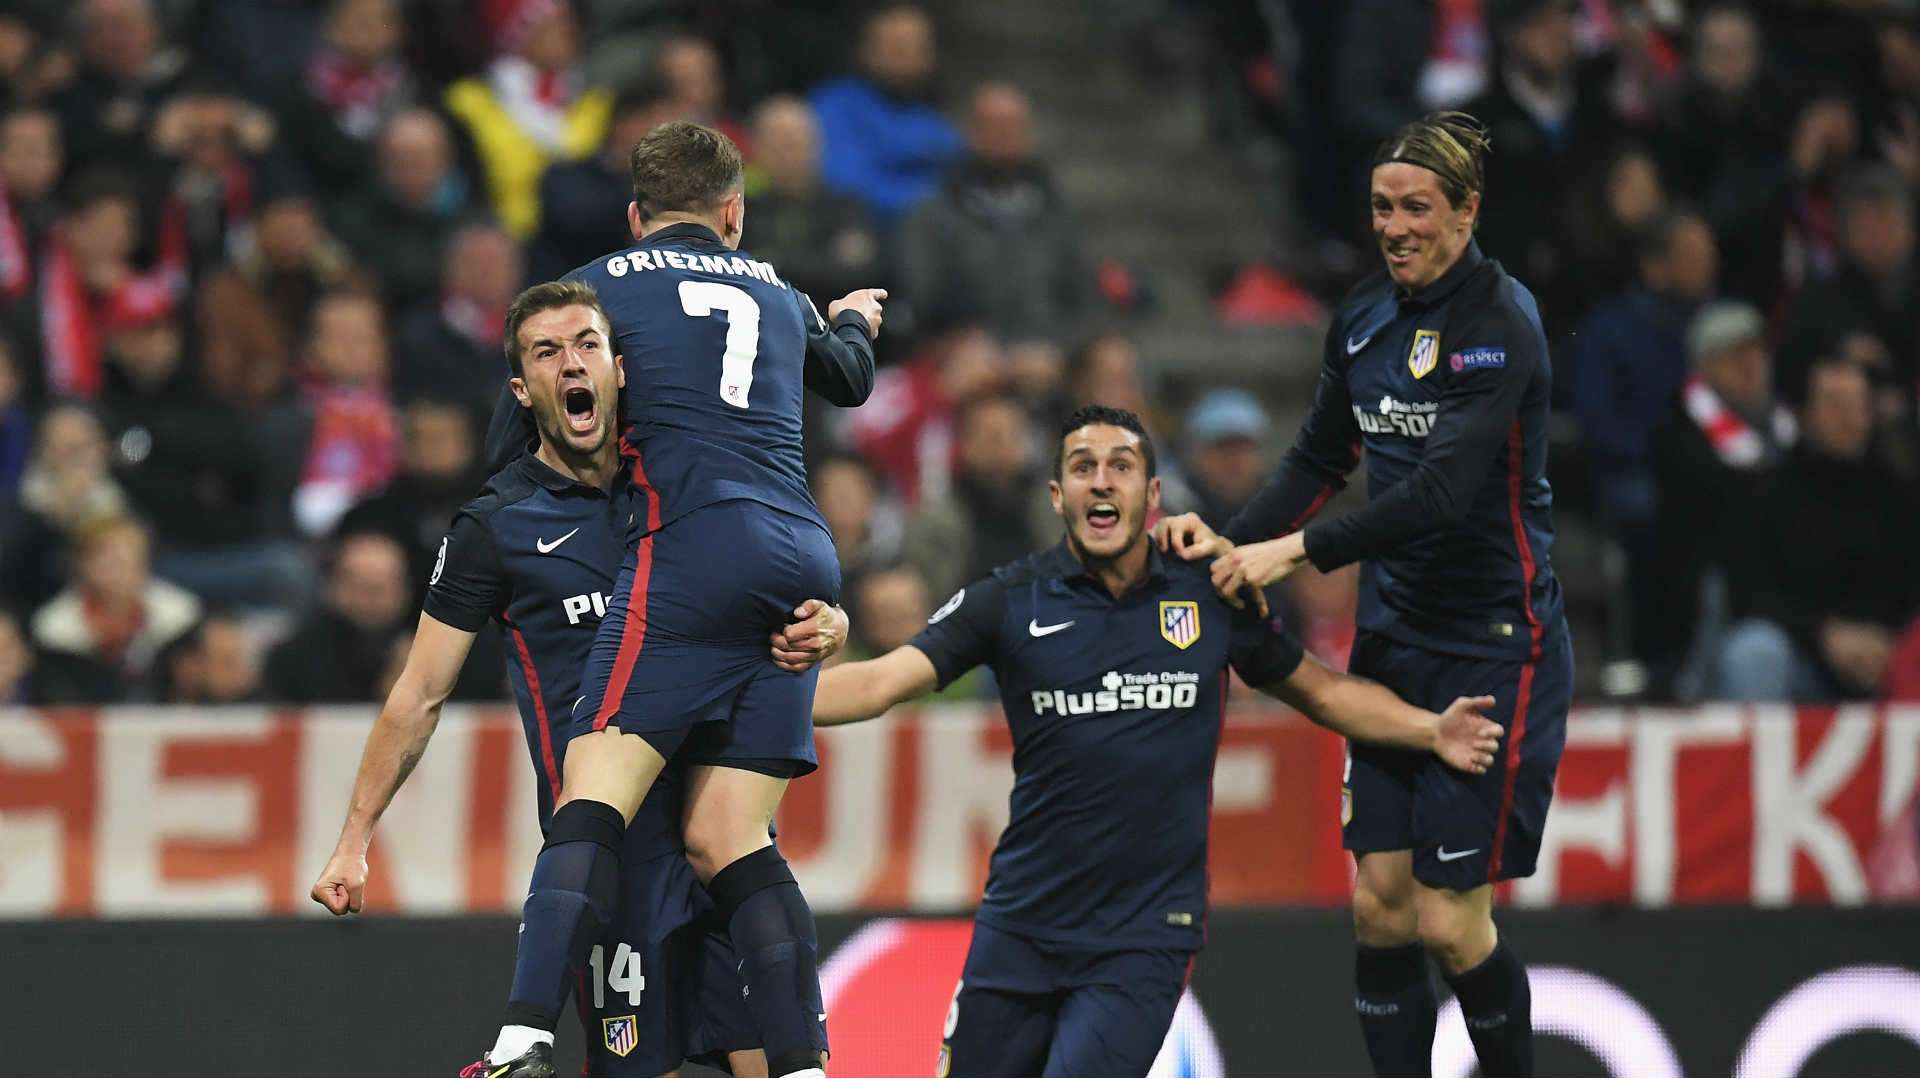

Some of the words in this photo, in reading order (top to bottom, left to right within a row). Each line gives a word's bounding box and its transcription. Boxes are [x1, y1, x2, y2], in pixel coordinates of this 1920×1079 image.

[607, 250, 786, 289] GRIEZMANN
[678, 281, 761, 408] 7
[1463, 351, 1505, 365] RESPECT
[1352, 403, 1437, 437] lus50
[562, 591, 612, 625] Pl
[1123, 672, 1159, 685] Trade
[1160, 671, 1199, 684] Online
[1031, 682, 1198, 716] Plus500
[588, 942, 645, 1009] 14
